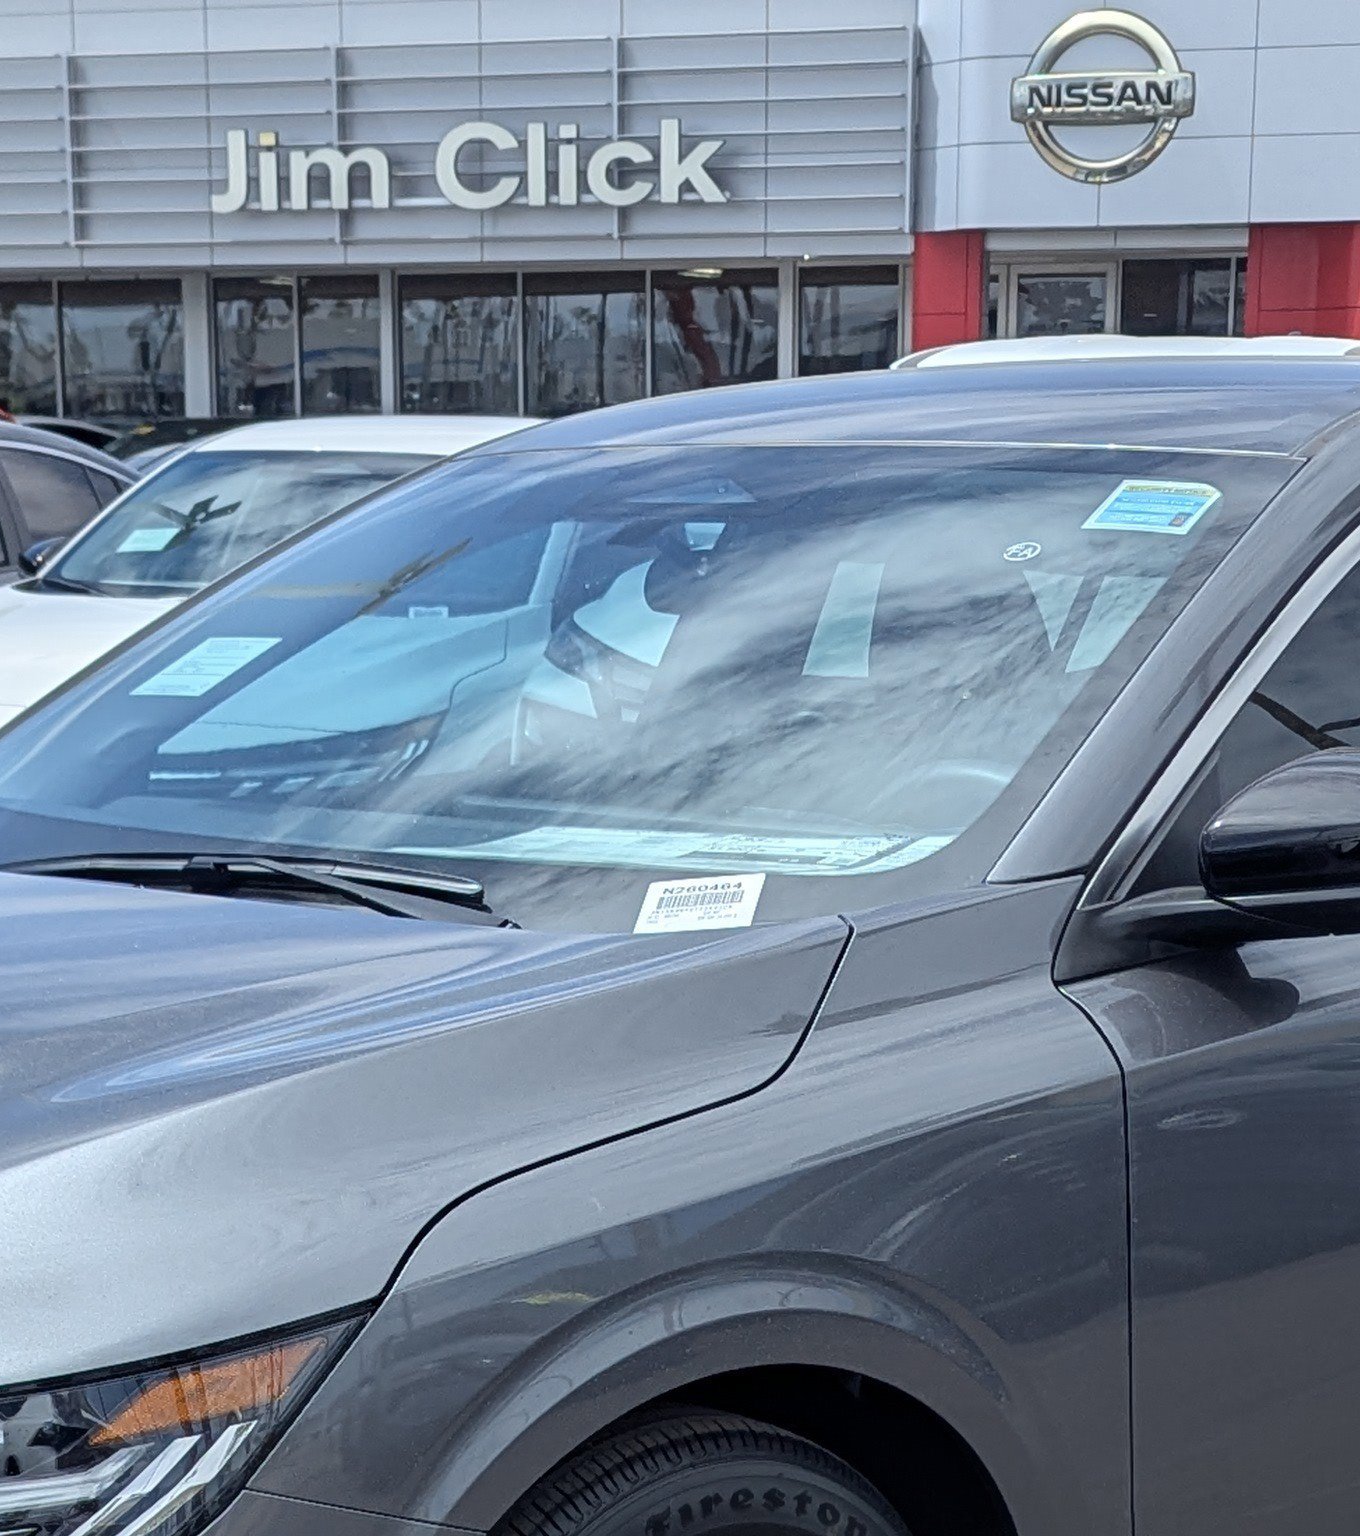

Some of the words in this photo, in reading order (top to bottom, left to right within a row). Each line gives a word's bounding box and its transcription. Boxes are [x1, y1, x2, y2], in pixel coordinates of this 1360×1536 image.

[1027, 79, 1173, 108] NISSAN
[212, 128, 391, 214] Jim
[435, 117, 729, 210] Click
